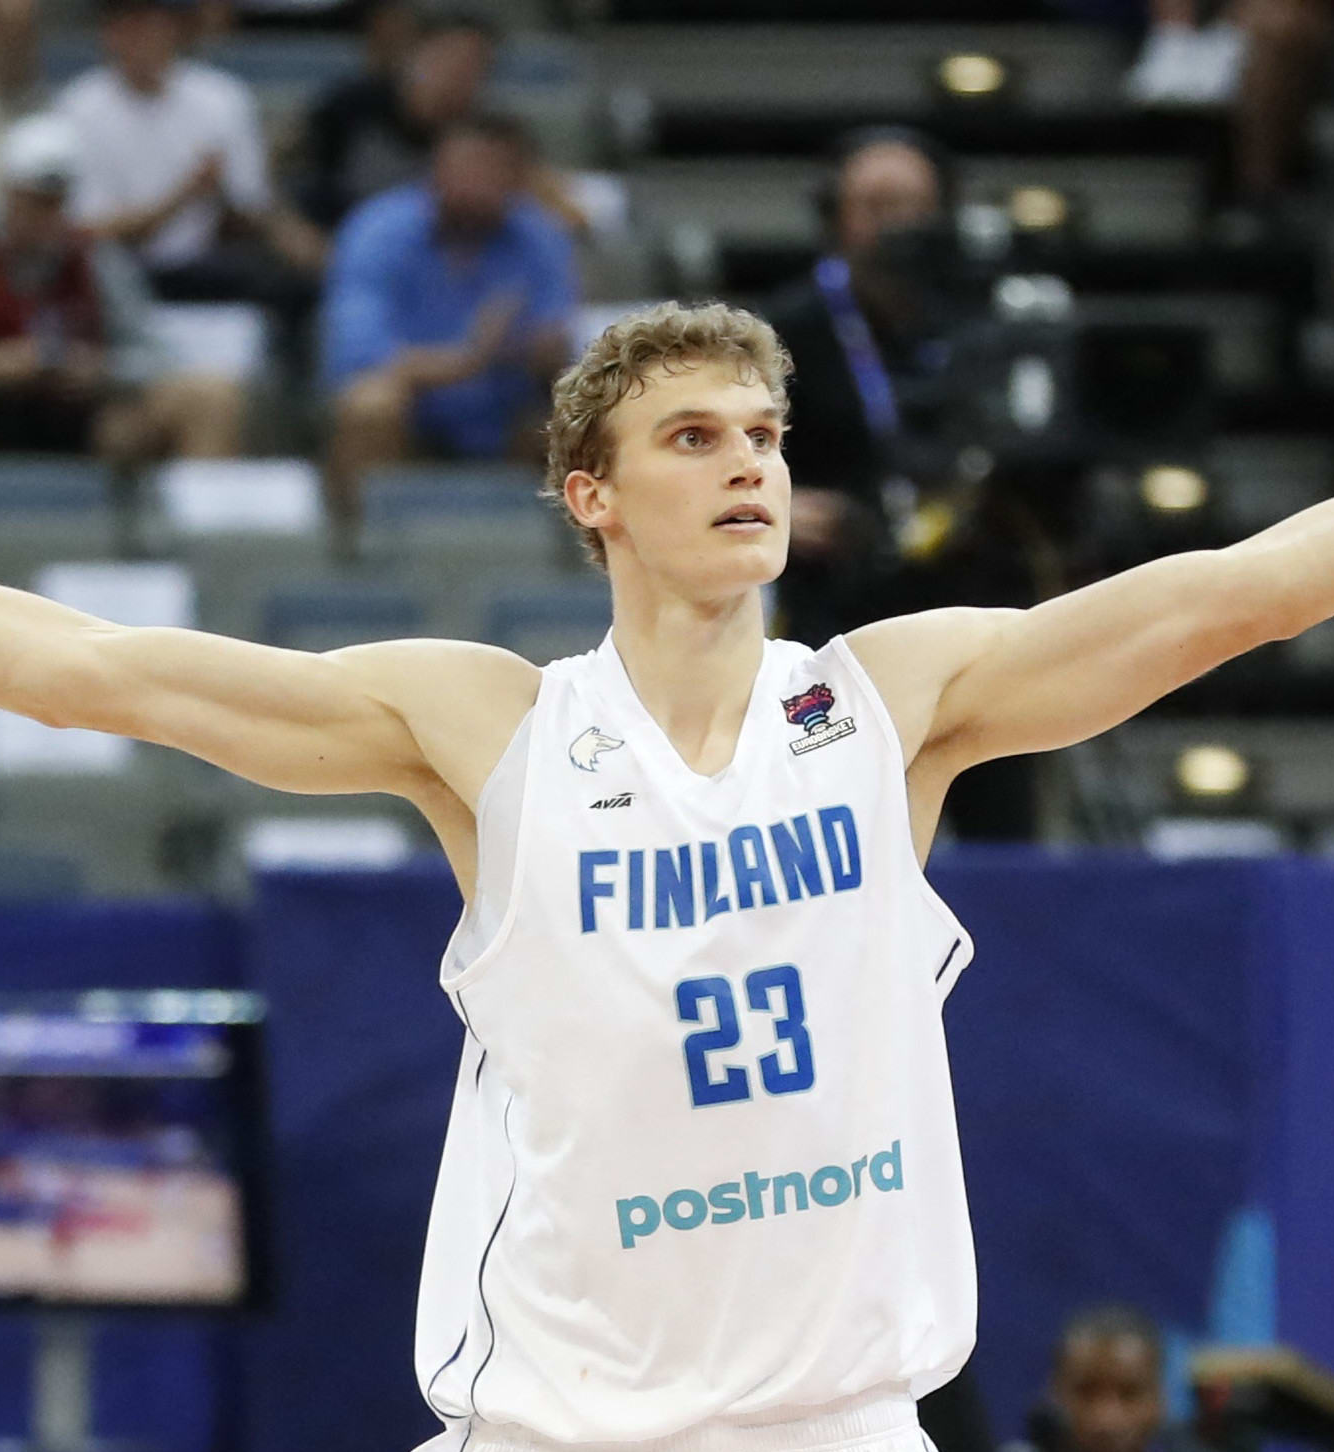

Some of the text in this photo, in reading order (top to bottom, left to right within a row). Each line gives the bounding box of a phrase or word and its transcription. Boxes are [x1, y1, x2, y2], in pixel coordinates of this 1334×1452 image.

[792, 720, 854, 750] EUROBASKET
[589, 793, 633, 809] AVIA
[578, 805, 863, 934] FINLAND
[675, 963, 816, 1110] 23
[616, 1140, 903, 1250] postnord
